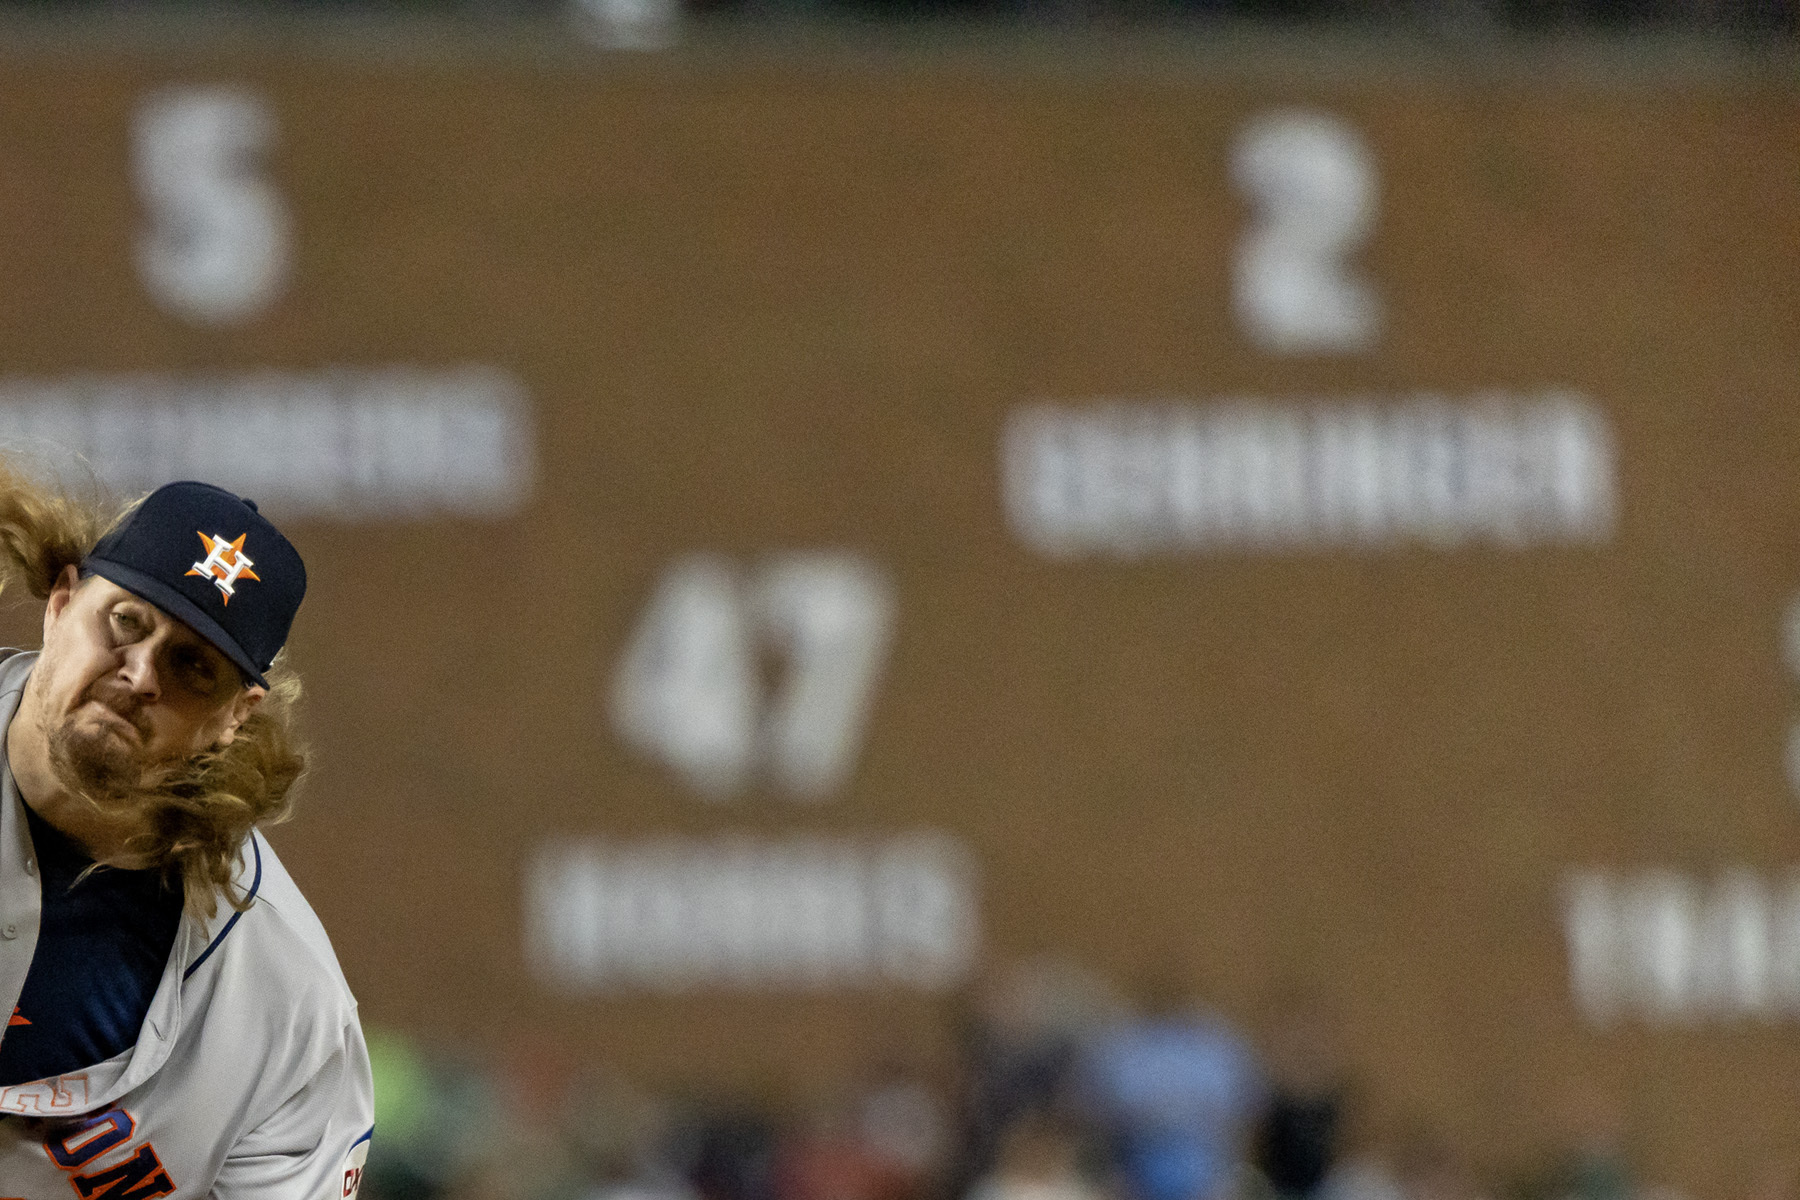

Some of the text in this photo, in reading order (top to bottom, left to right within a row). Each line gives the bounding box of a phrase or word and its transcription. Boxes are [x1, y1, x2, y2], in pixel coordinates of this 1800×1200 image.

[133, 87, 290, 322] 5
[1232, 110, 1378, 352] 2
[191, 533, 255, 597] H
[614, 554, 892, 792] 47
